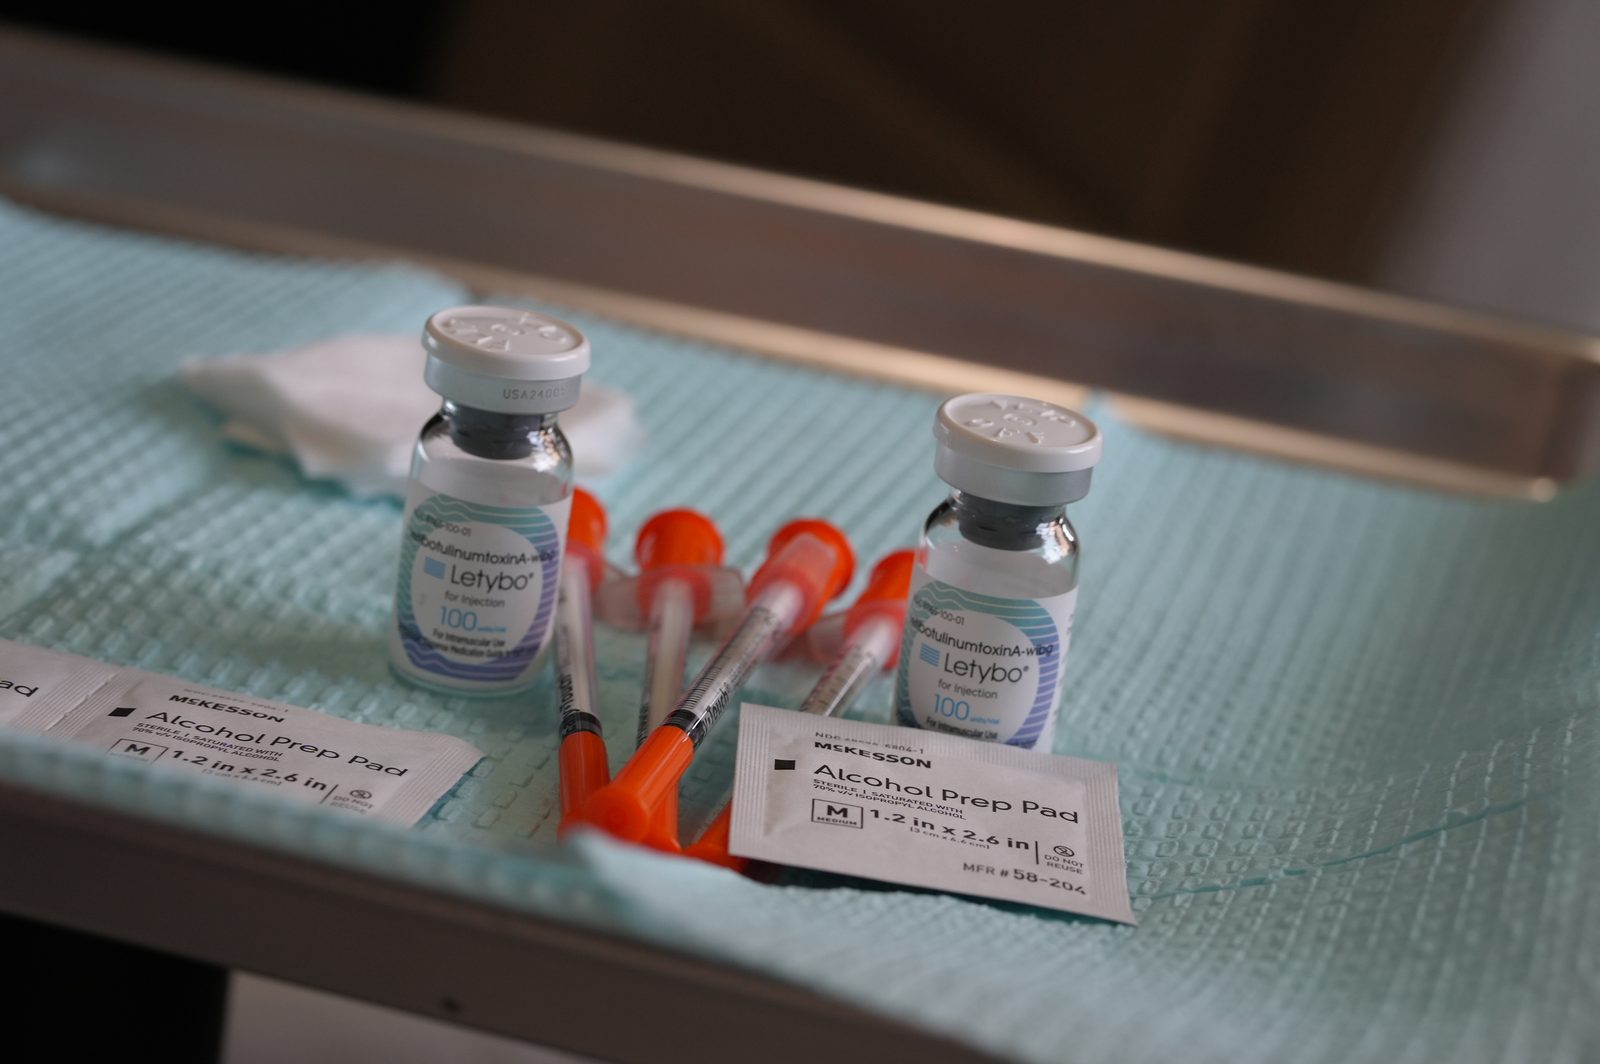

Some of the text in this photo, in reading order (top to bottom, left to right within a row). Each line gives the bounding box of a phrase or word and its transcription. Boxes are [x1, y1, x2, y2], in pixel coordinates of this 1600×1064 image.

[440, 605, 477, 632] 100
[938, 678, 998, 699] for Injection
[934, 693, 971, 722] 100
[124, 743, 151, 756] M
[132, 726, 154, 735] 70%
[172, 734, 230, 754] ISOPROPYL
[231, 750, 281, 763] ALCOHOL
[137, 722, 284, 757] STERILE SATURATED WITH
[146, 711, 409, 777] Alcohol Prep Pad
[172, 750, 328, 792] 1.2 in x 2.6 in
[813, 778, 964, 814] STERILE SATURATED WITH
[813, 783, 967, 821] 70% v/v ISOPROPYL ALCOHOL
[814, 764, 1079, 824] Alcohol Prep Pad
[817, 816, 857, 826] MEDIUM
[826, 804, 848, 819] M
[870, 808, 1030, 850] 1.2 in x 2.6 in
[1044, 854, 1085, 869] DO NOT
[1046, 861, 1084, 876] REUSE
[962, 862, 1088, 896] MFR # 58-204
